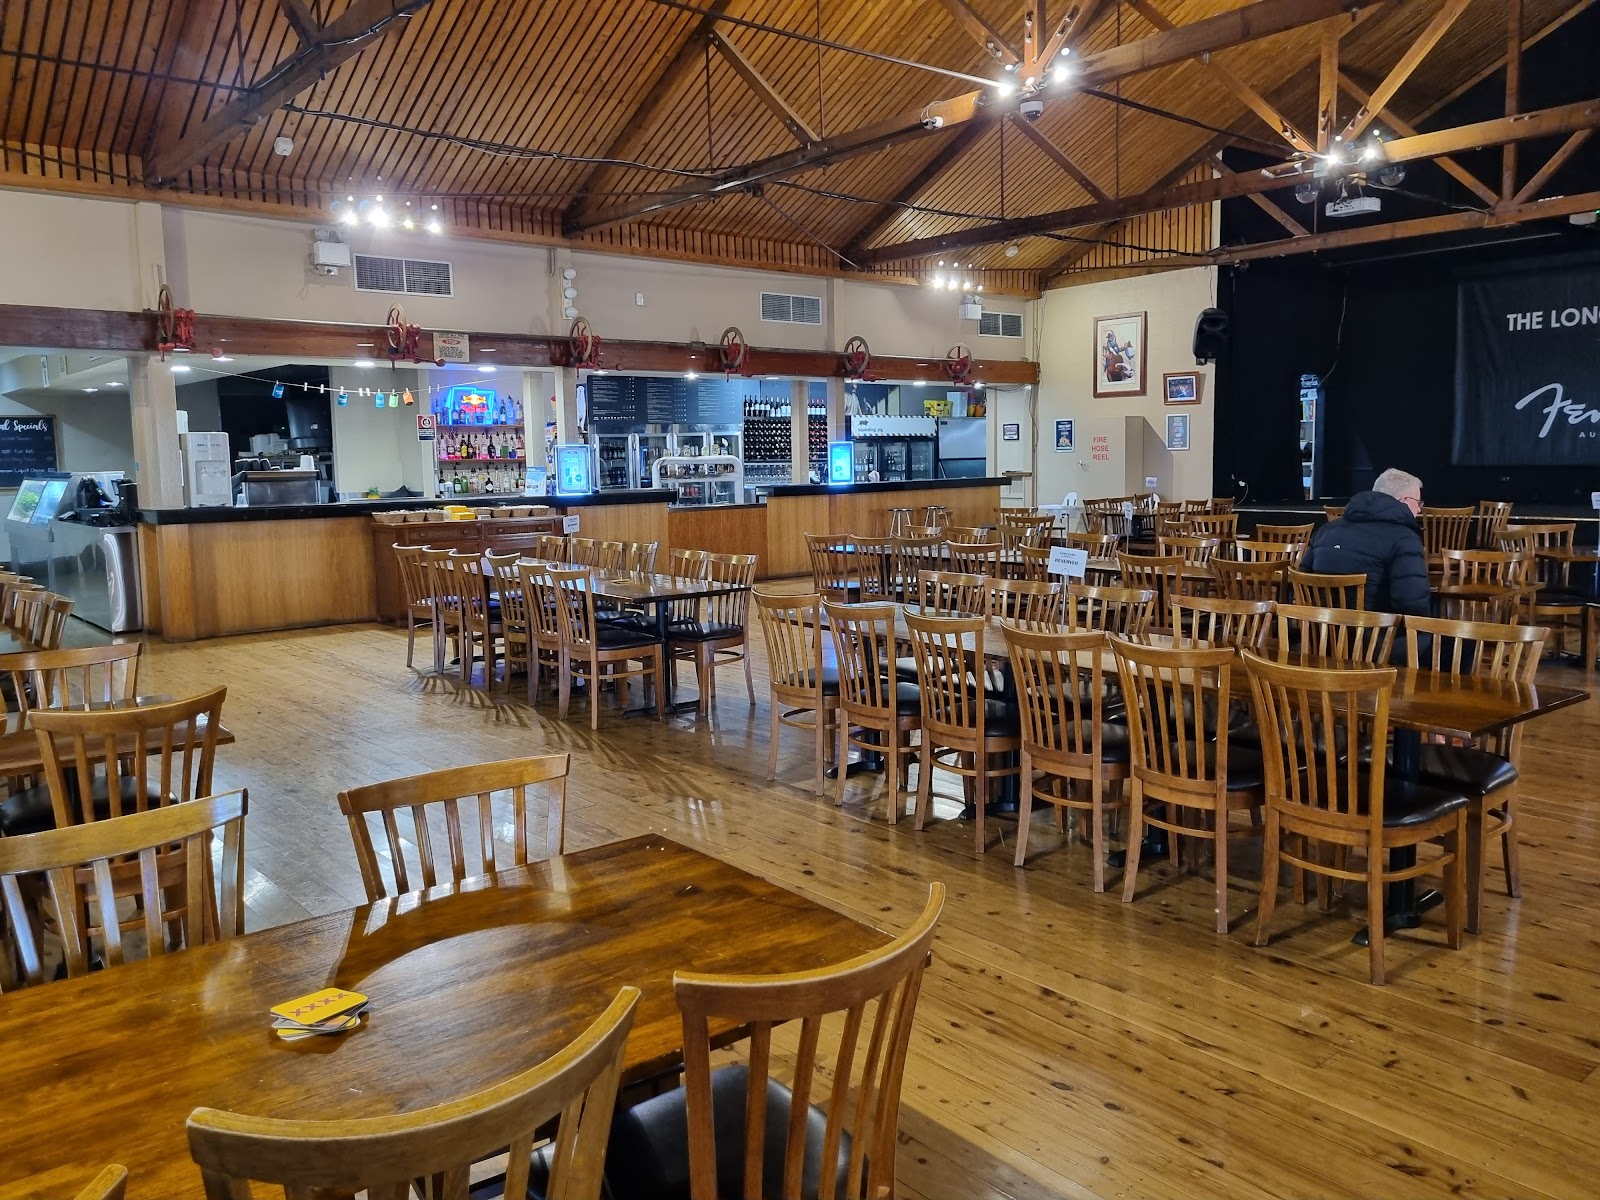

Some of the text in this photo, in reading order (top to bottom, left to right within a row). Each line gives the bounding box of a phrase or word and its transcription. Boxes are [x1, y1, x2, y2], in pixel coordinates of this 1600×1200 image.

[1506, 305, 1600, 331] THE LON
[1093, 436, 1108, 444] FIRE
[1092, 453, 1110, 461] REEL
[1054, 558, 1079, 566] RESERVED
